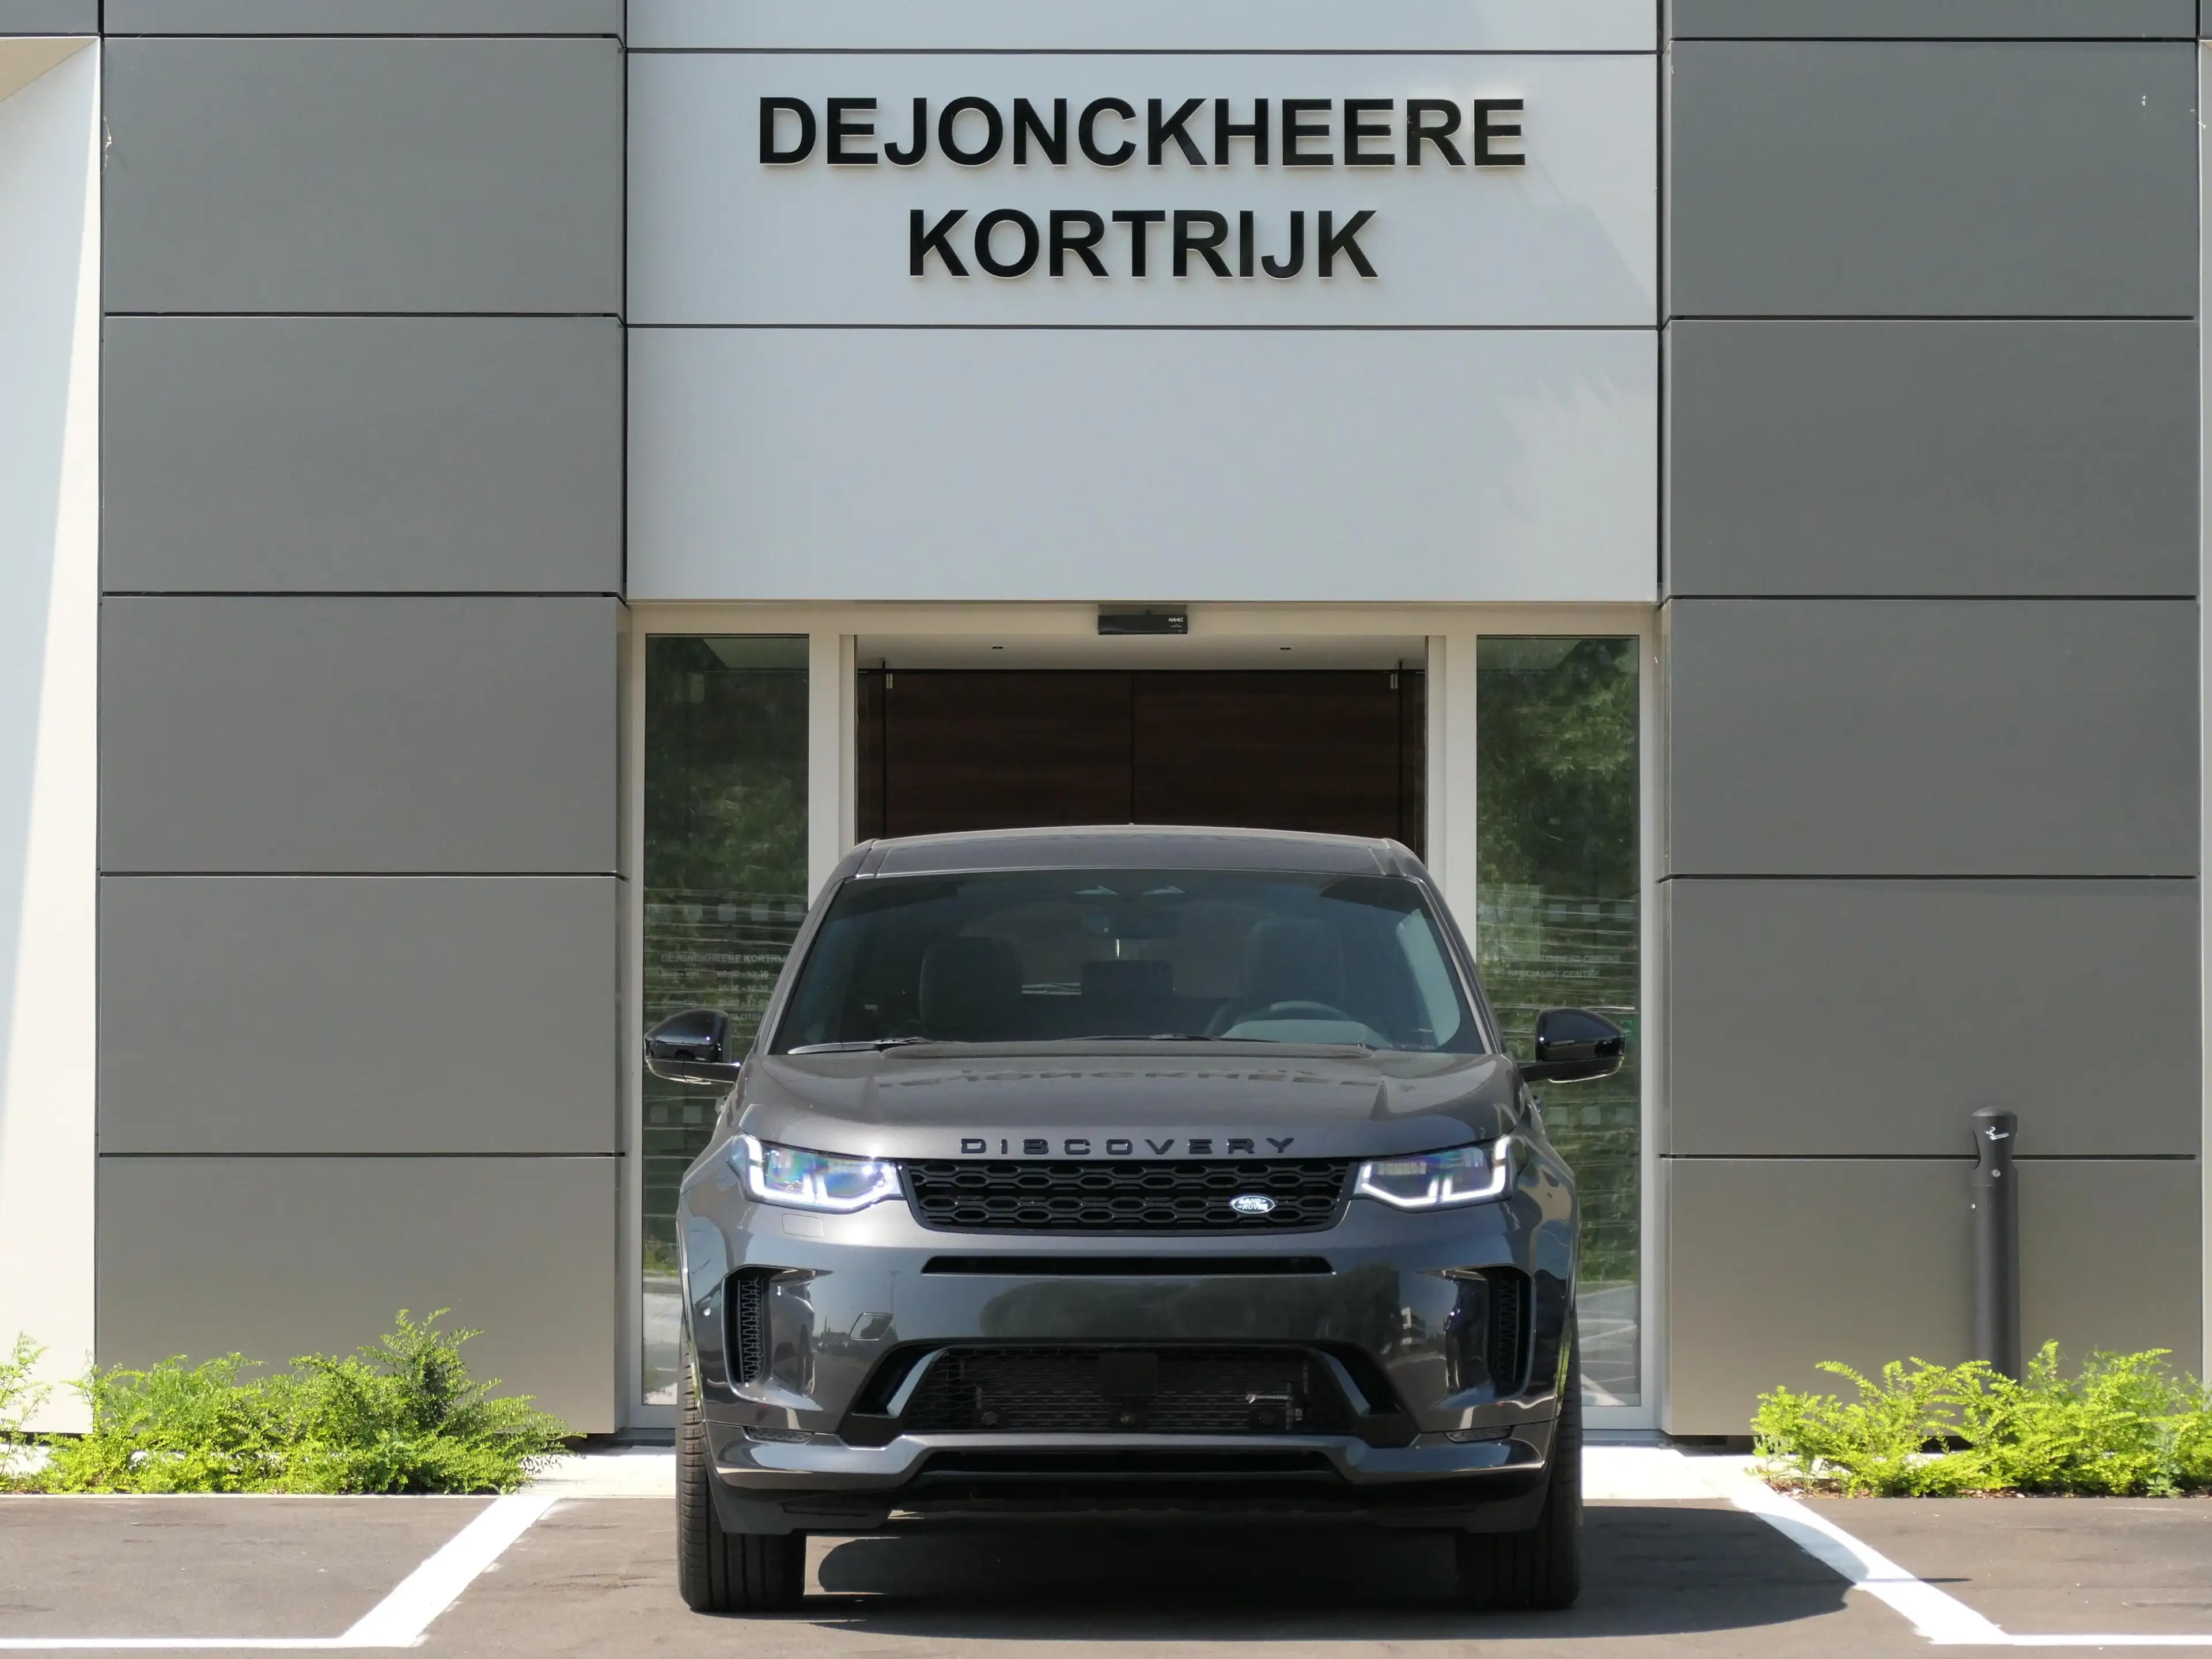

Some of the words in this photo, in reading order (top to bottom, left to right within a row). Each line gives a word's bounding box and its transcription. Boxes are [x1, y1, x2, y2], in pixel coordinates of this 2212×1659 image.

[760, 96, 1525, 166] DEJONCKHEERE
[910, 209, 1378, 279] KORTRIJK
[744, 953, 787, 963] KORTRIJ
[1537, 955, 1581, 963] USINESS
[1508, 969, 1560, 978] SPECIALIST
[1563, 969, 1600, 978] CENTRE
[961, 1138, 1294, 1155] DISCOVERY
